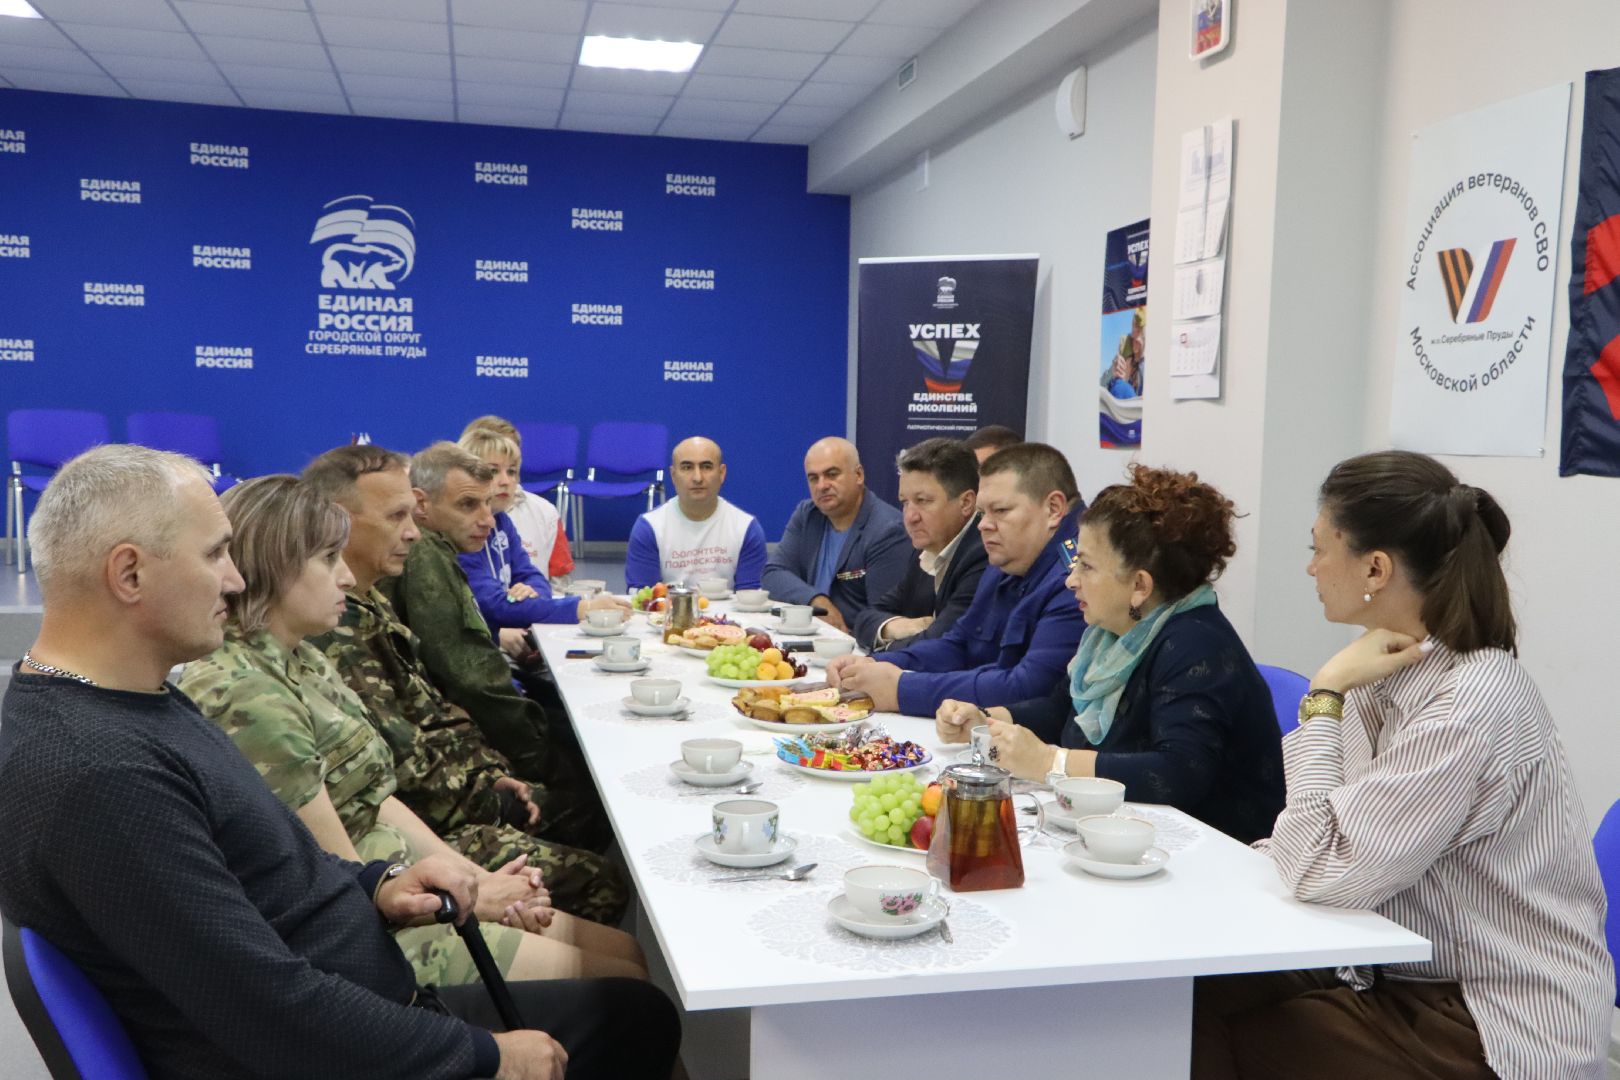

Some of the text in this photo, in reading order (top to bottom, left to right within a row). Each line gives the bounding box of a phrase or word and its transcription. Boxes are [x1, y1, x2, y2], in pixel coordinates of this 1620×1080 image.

[190, 143, 248, 156] ЕДИНАЯ
[190, 155, 248, 168] РОССИЯ
[474, 162, 527, 174] ЕДИНАЯ
[81, 179, 141, 191] ЕДИНАЯ
[474, 173, 527, 185] РОССИЯ
[666, 174, 715, 185] ЕДИНАЯ
[666, 184, 715, 196] РОССИЯ
[81, 190, 141, 203] РОССИЯ
[571, 208, 623, 220] ЕДИНАЯ
[571, 219, 623, 231] РОССИЯ
[1406, 172, 1549, 290] Ассоциация ветеранов СВО
[193, 246, 250, 258] ЕДИНАЯ
[193, 257, 250, 269] РОССИЯ
[476, 260, 528, 271] ЕДИНАЯ
[476, 270, 528, 282] РОССИЯ
[665, 268, 714, 279] ЕДИНАЯ
[84, 283, 144, 294] ЕДИНАЯ
[665, 278, 714, 289] РОССИЯ
[84, 293, 144, 306] РОССИЯ
[318, 294, 413, 312] ЕДИНАЯ
[571, 304, 622, 315] ЕДИНАЯ
[318, 313, 413, 332] РОССИЯ
[571, 314, 622, 325] РОССИЯ
[308, 329, 422, 343] ГОРОДСКОЙ ОКРУГ
[909, 323, 981, 339] УСПЕХ
[195, 346, 253, 358] ЕДИНАЯ
[305, 343, 427, 358] СЕРЕБРЯНЫЕ ПРУДЫ
[1410, 315, 1536, 392] Московской области
[195, 357, 253, 368] РОССИЯ
[476, 356, 528, 367] ЕДИНАЯ
[664, 361, 713, 372] ЕДИНАЯ
[476, 366, 528, 377] РОССИЯ
[664, 371, 713, 381] РОССИЯ
[913, 392, 973, 402] ЕДИНСТВЕ
[908, 402, 977, 413] ПОКОЛЕНИЙ
